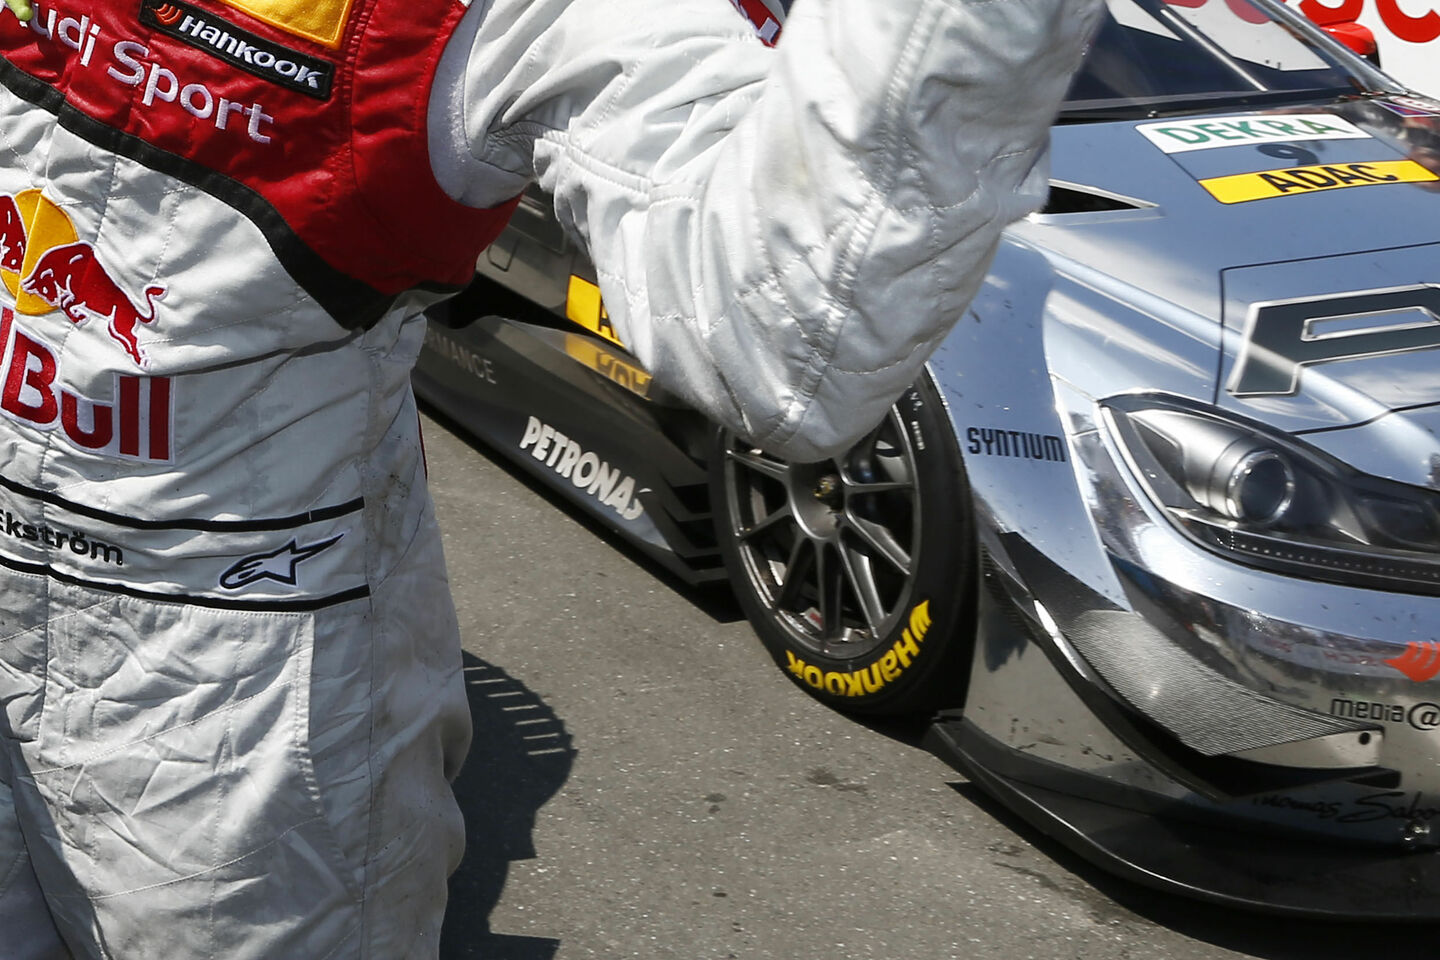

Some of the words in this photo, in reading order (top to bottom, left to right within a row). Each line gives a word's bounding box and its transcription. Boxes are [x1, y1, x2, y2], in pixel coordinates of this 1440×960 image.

[178, 14, 320, 89] Hankook
[107, 40, 274, 144] Sport
[1155, 118, 1355, 145] DEKRA
[1257, 163, 1399, 193] ADAC
[967, 427, 1066, 462] SYNTIUM
[786, 637, 918, 697] Hankook
